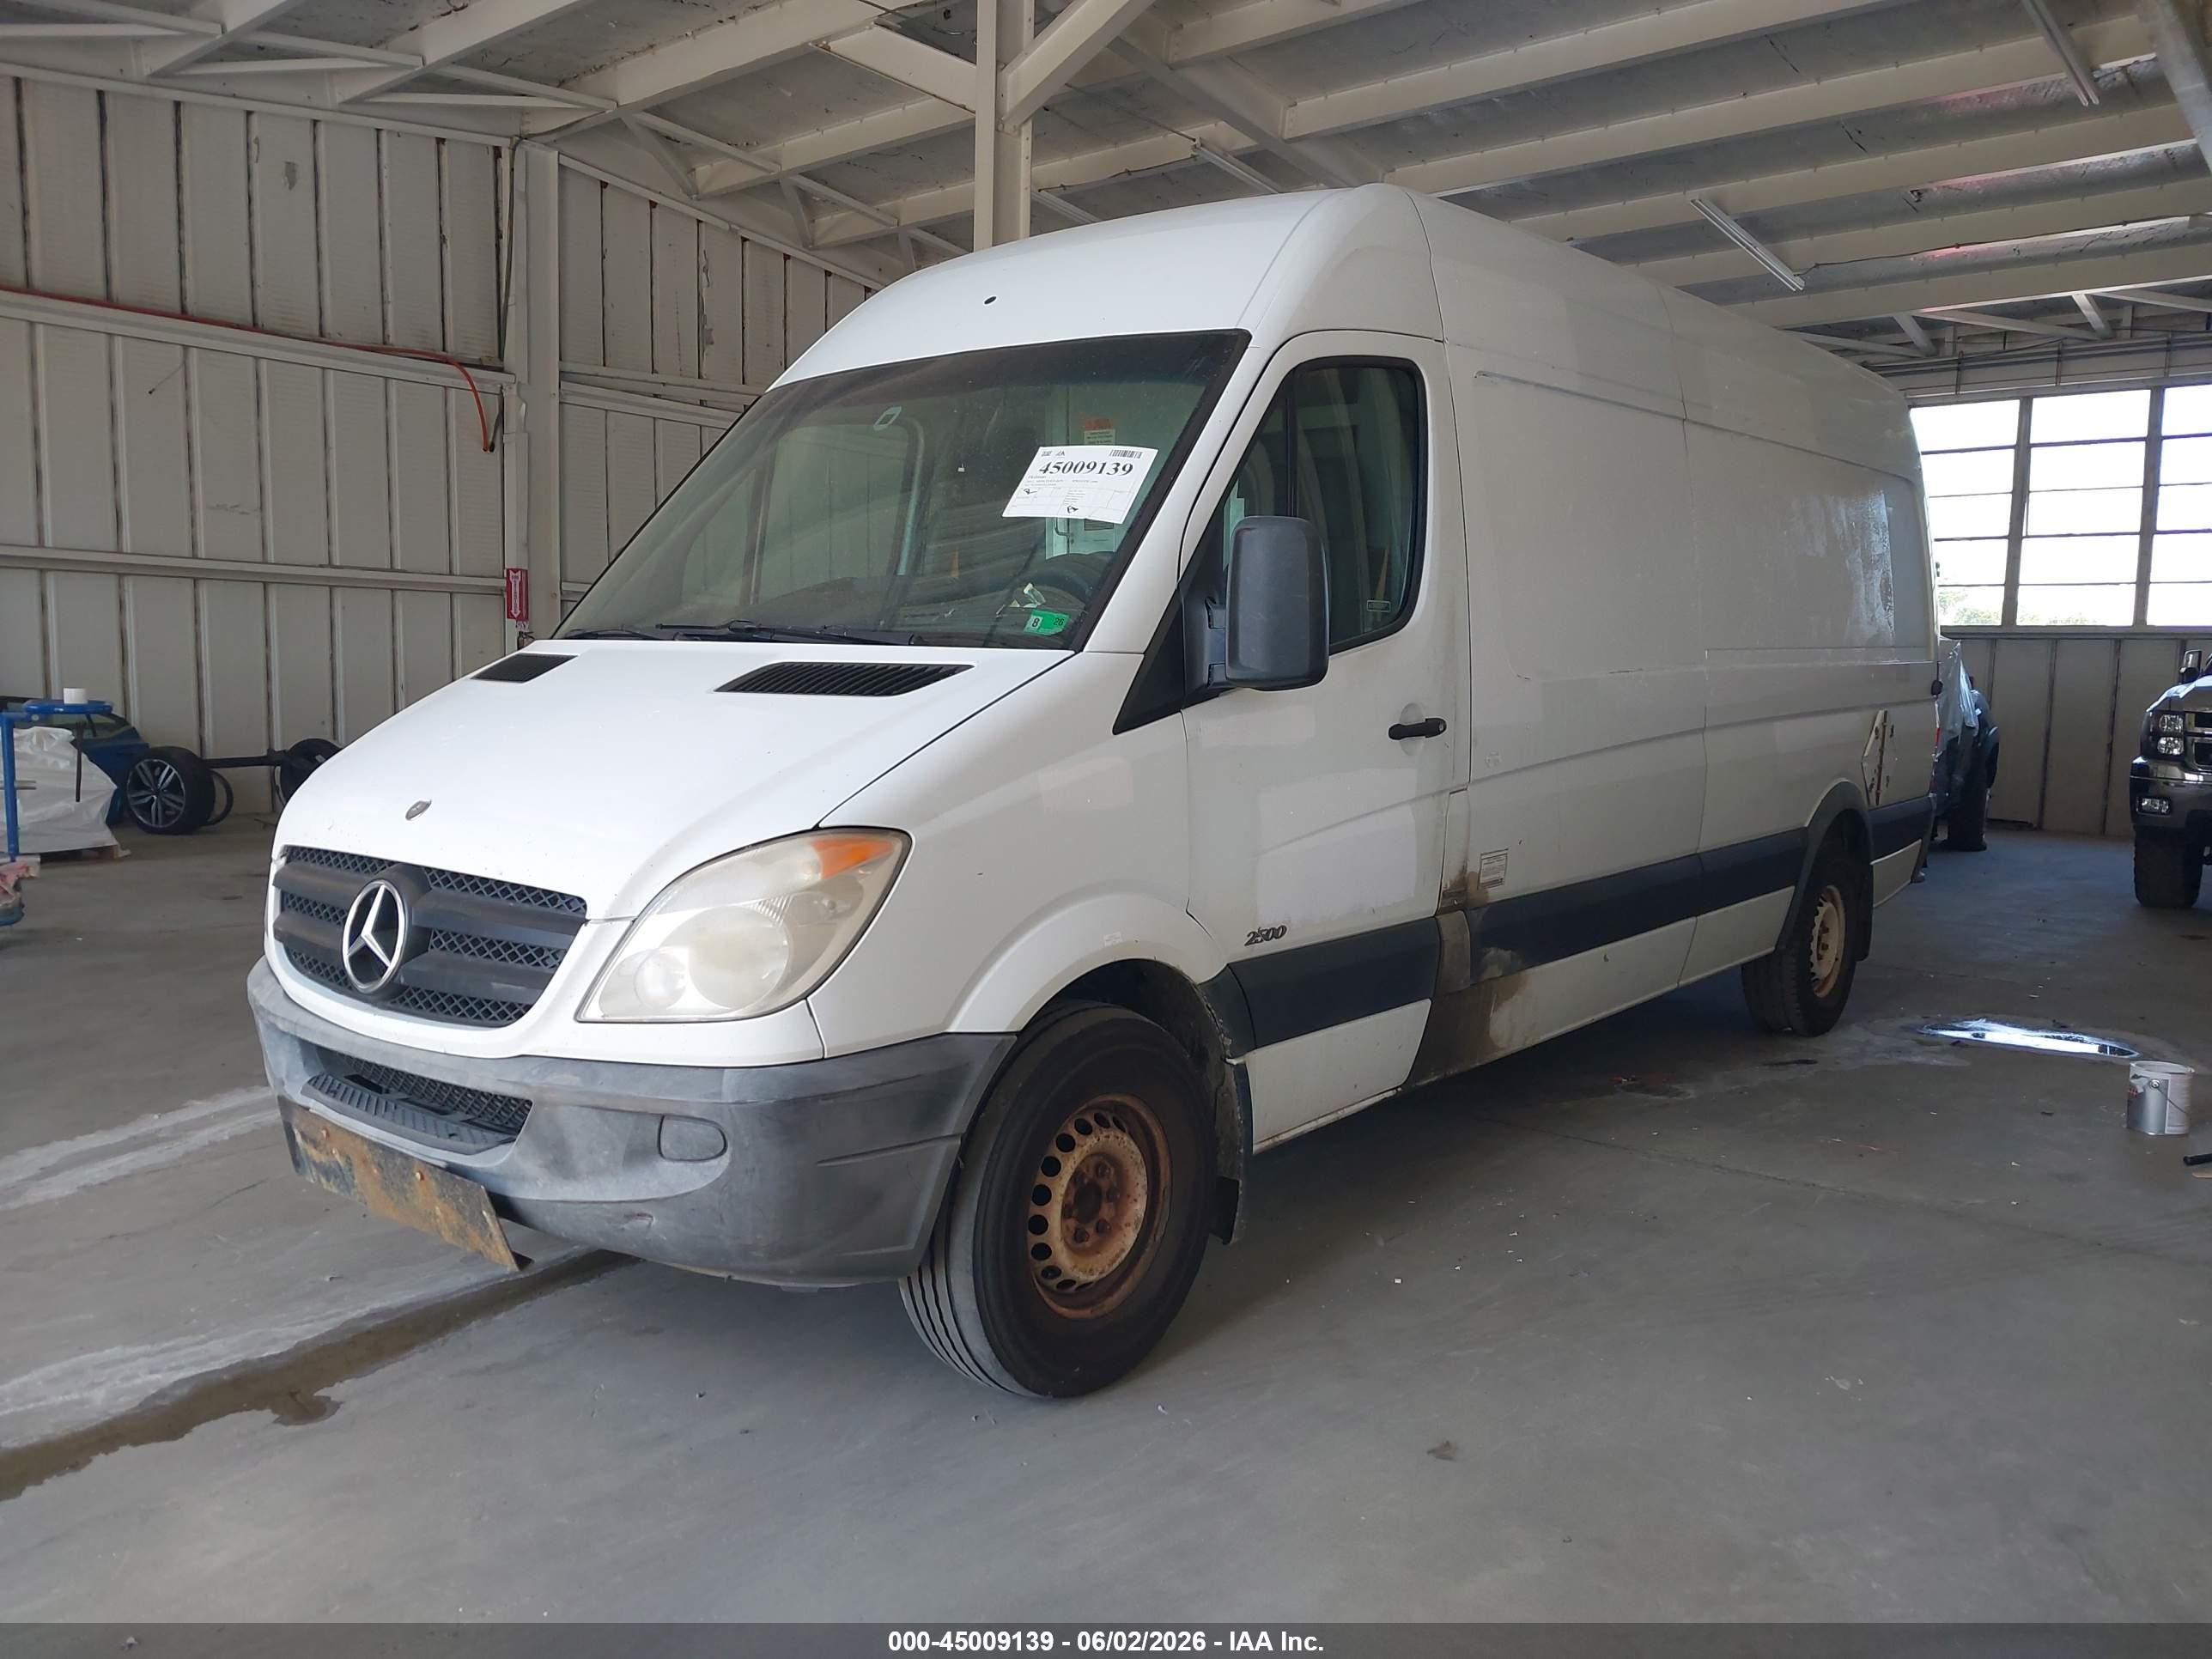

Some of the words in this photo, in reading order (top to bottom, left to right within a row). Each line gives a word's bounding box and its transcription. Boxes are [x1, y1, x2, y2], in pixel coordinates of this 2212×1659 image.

[1038, 460, 1133, 477] 45009139
[1032, 617, 1040, 627] 8
[1053, 617, 1064, 626] 26
[1243, 925, 1287, 946] 2500
